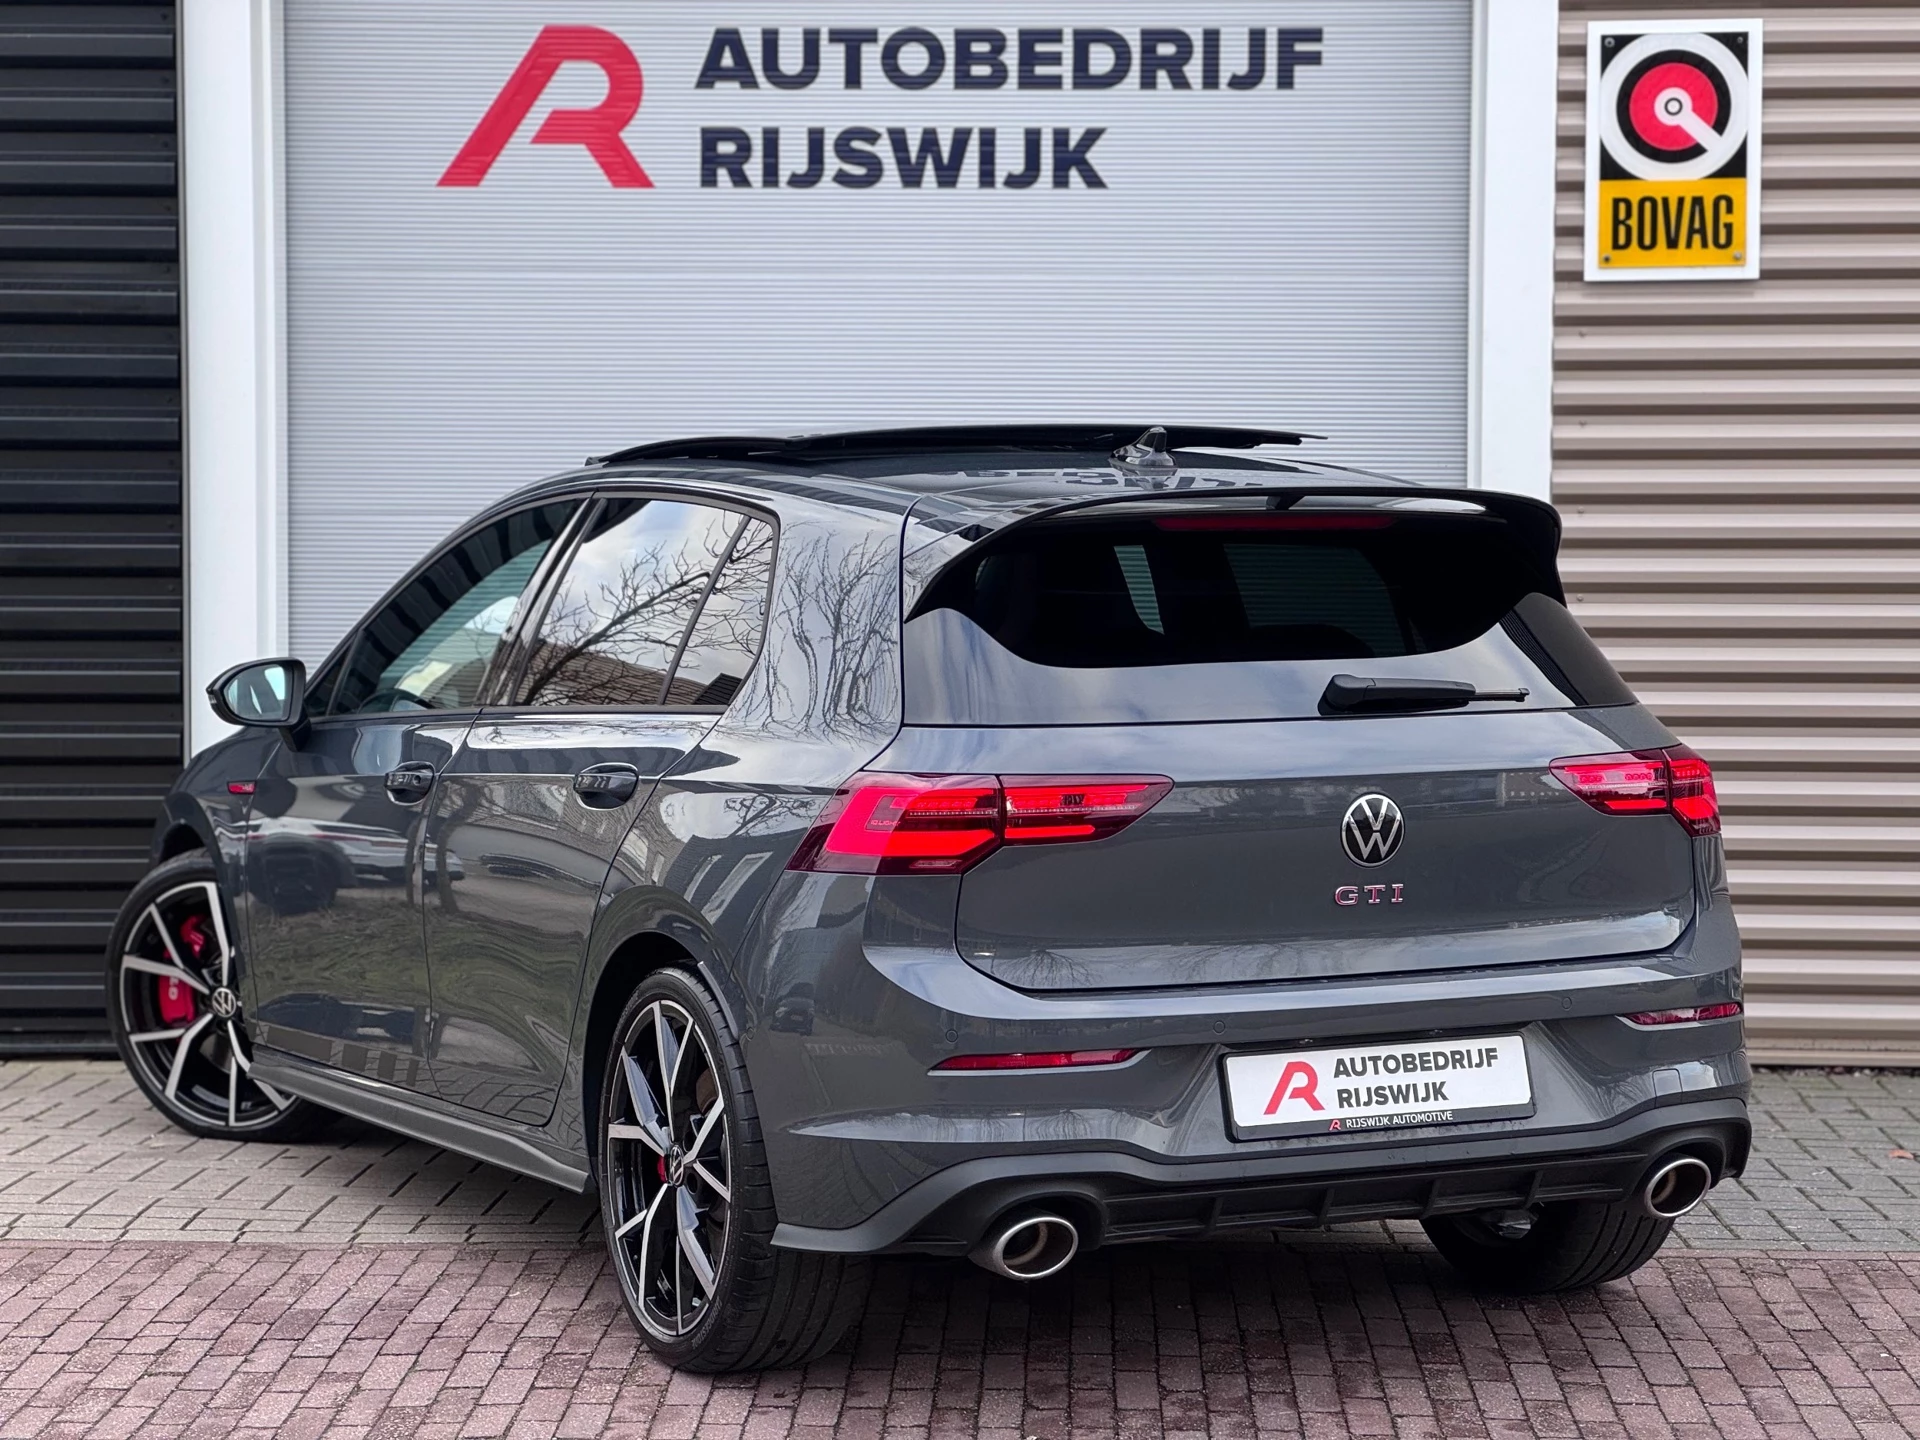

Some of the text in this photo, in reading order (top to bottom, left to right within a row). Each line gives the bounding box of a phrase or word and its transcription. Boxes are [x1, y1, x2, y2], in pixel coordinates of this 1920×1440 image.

[694, 26, 1324, 90] AUTOBEDRIJF
[699, 127, 1109, 189] RIJSWIJK
[1611, 194, 1734, 251] BOVAG
[1334, 883, 1404, 906] GTI
[1333, 1047, 1499, 1079] AUTOBEDRIJF
[1336, 1081, 1450, 1109] RIJSWIJK
[1345, 1116, 1390, 1128] RIJSWIJK
[1392, 1110, 1453, 1125] AUTOMOTIVE
